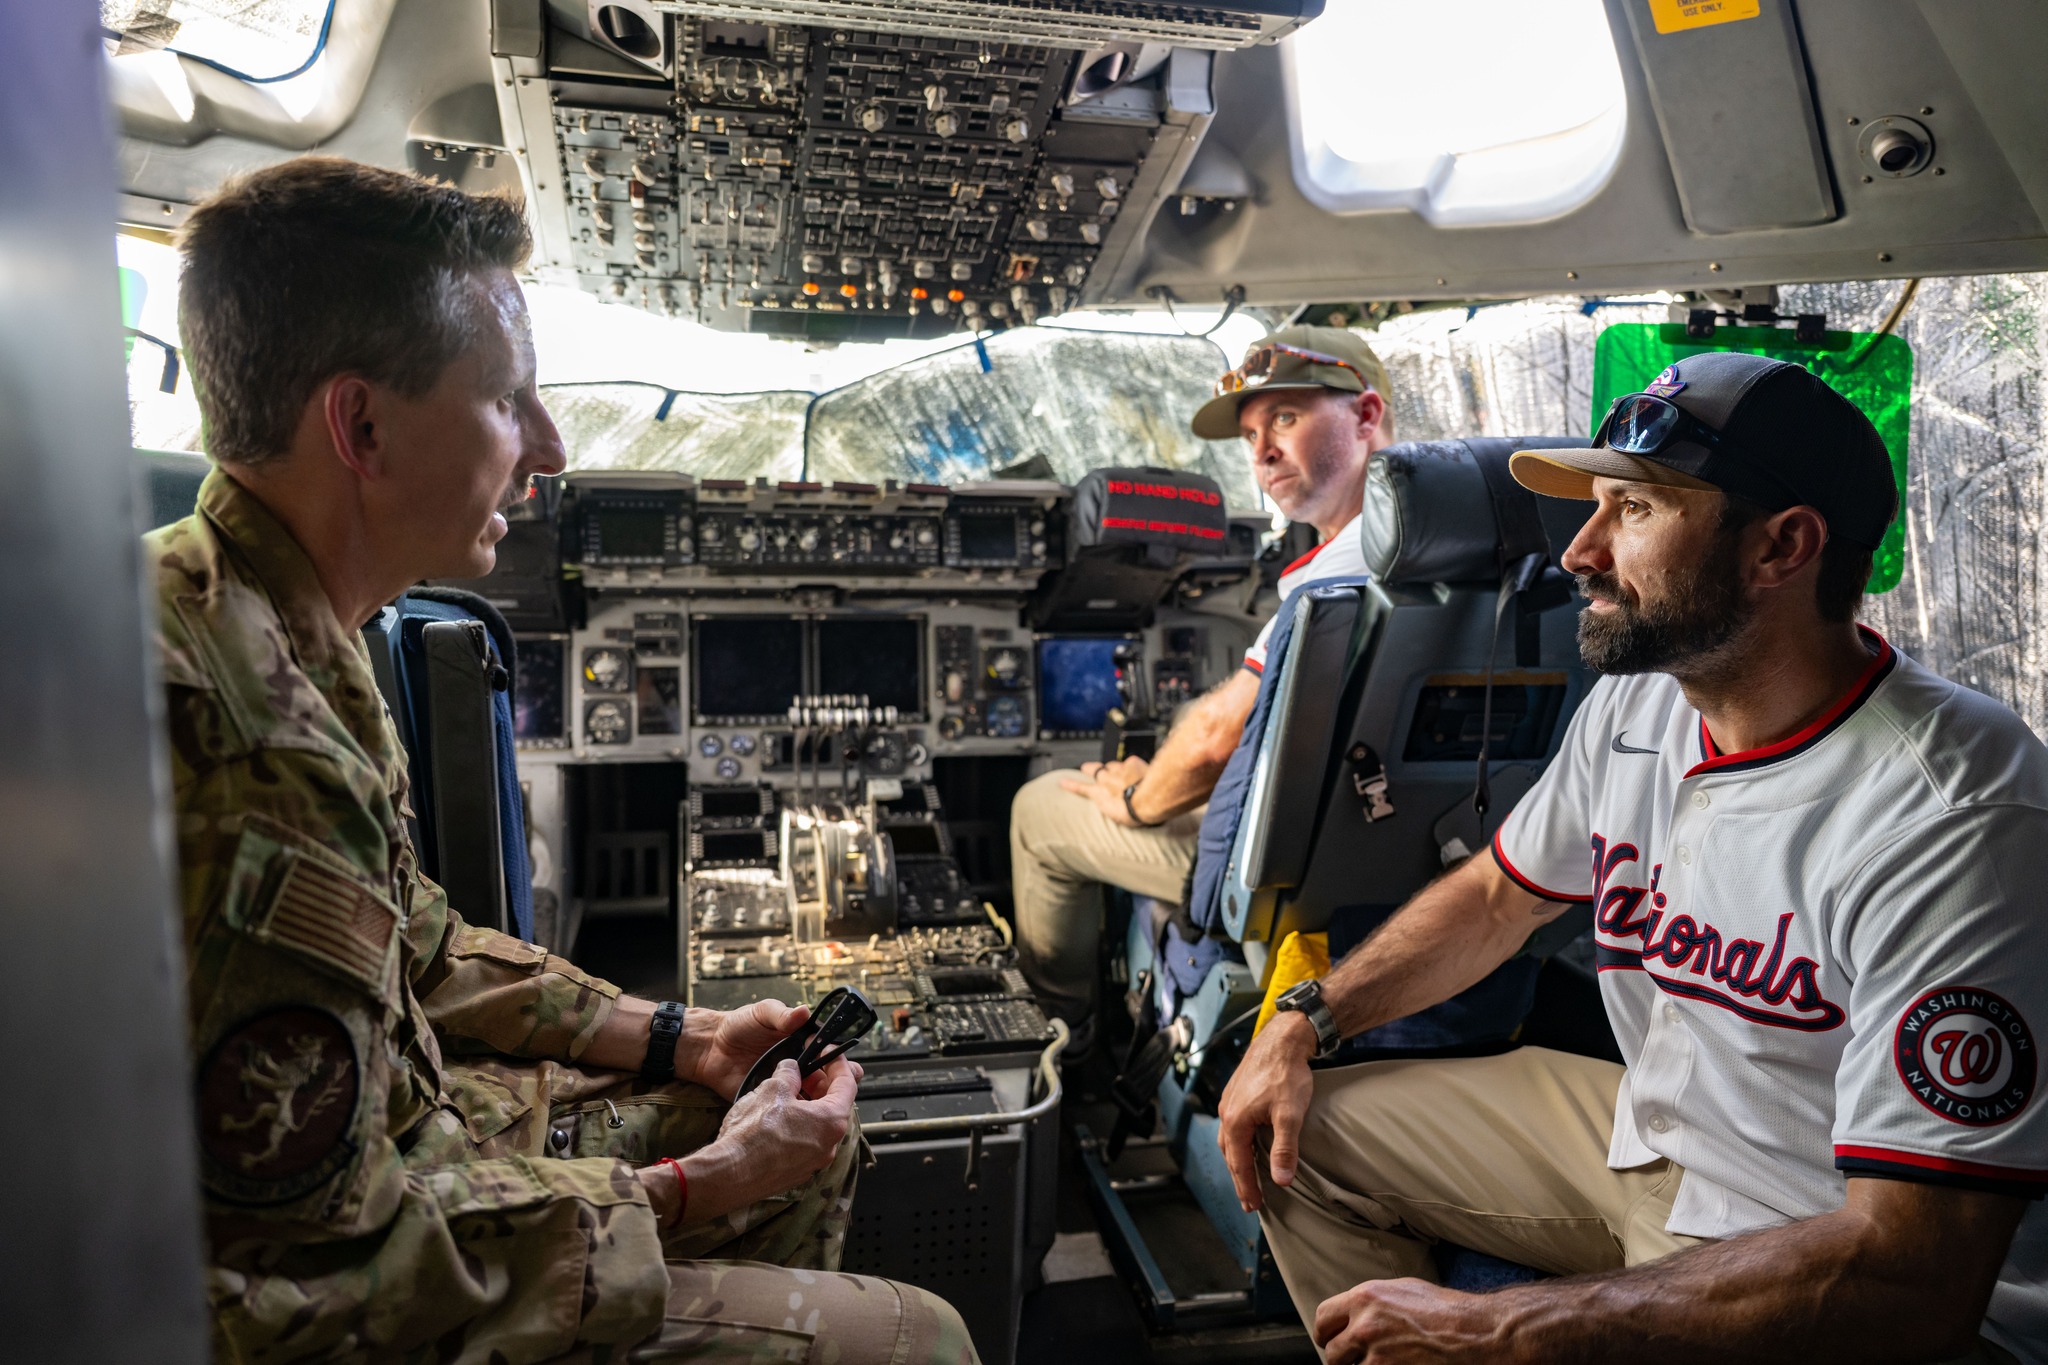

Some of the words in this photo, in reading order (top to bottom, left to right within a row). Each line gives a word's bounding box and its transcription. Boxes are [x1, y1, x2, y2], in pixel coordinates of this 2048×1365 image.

[1683, 7, 1699, 16] USE
[1108, 480, 1133, 494] NO
[1134, 482, 1178, 499] HAND
[1179, 488, 1220, 506] HOLD
[1149, 521, 1187, 533] BEFORE
[1189, 525, 1225, 540] FLIGHT
[1904, 993, 2029, 1050] WASHINGTON
[1931, 1027, 2002, 1086] W
[1908, 1070, 2024, 1119] NATIONALS
